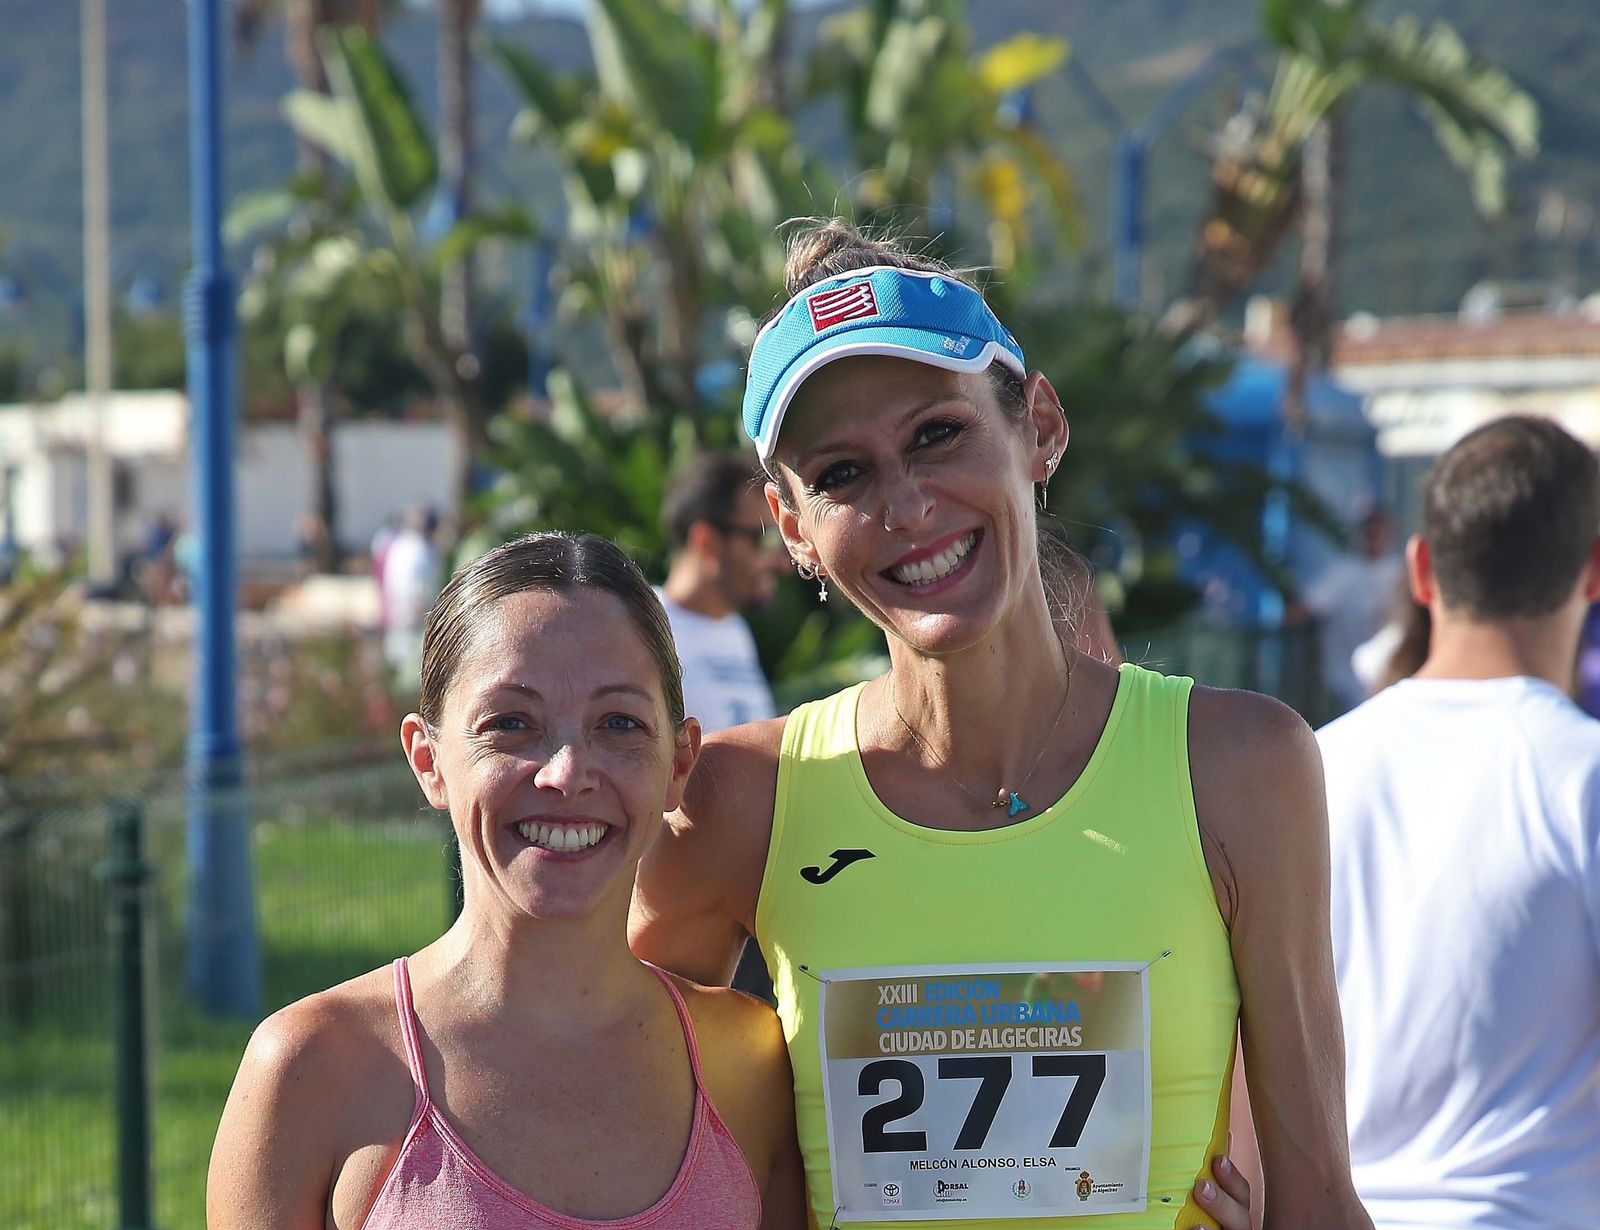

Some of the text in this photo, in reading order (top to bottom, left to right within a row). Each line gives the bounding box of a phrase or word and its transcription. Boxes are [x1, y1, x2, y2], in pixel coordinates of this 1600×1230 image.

[878, 977, 1000, 1005] XXIII EDICIÓN
[876, 1000, 1081, 1030] CARRERA URBANA
[878, 1026, 1083, 1054] CIUDAD DE ALGECIRAS
[857, 1053, 1107, 1154] 277
[909, 1157, 1057, 1171] MELCÓN ALONSO, ELSA
[937, 1179, 969, 1194] DORSAL
